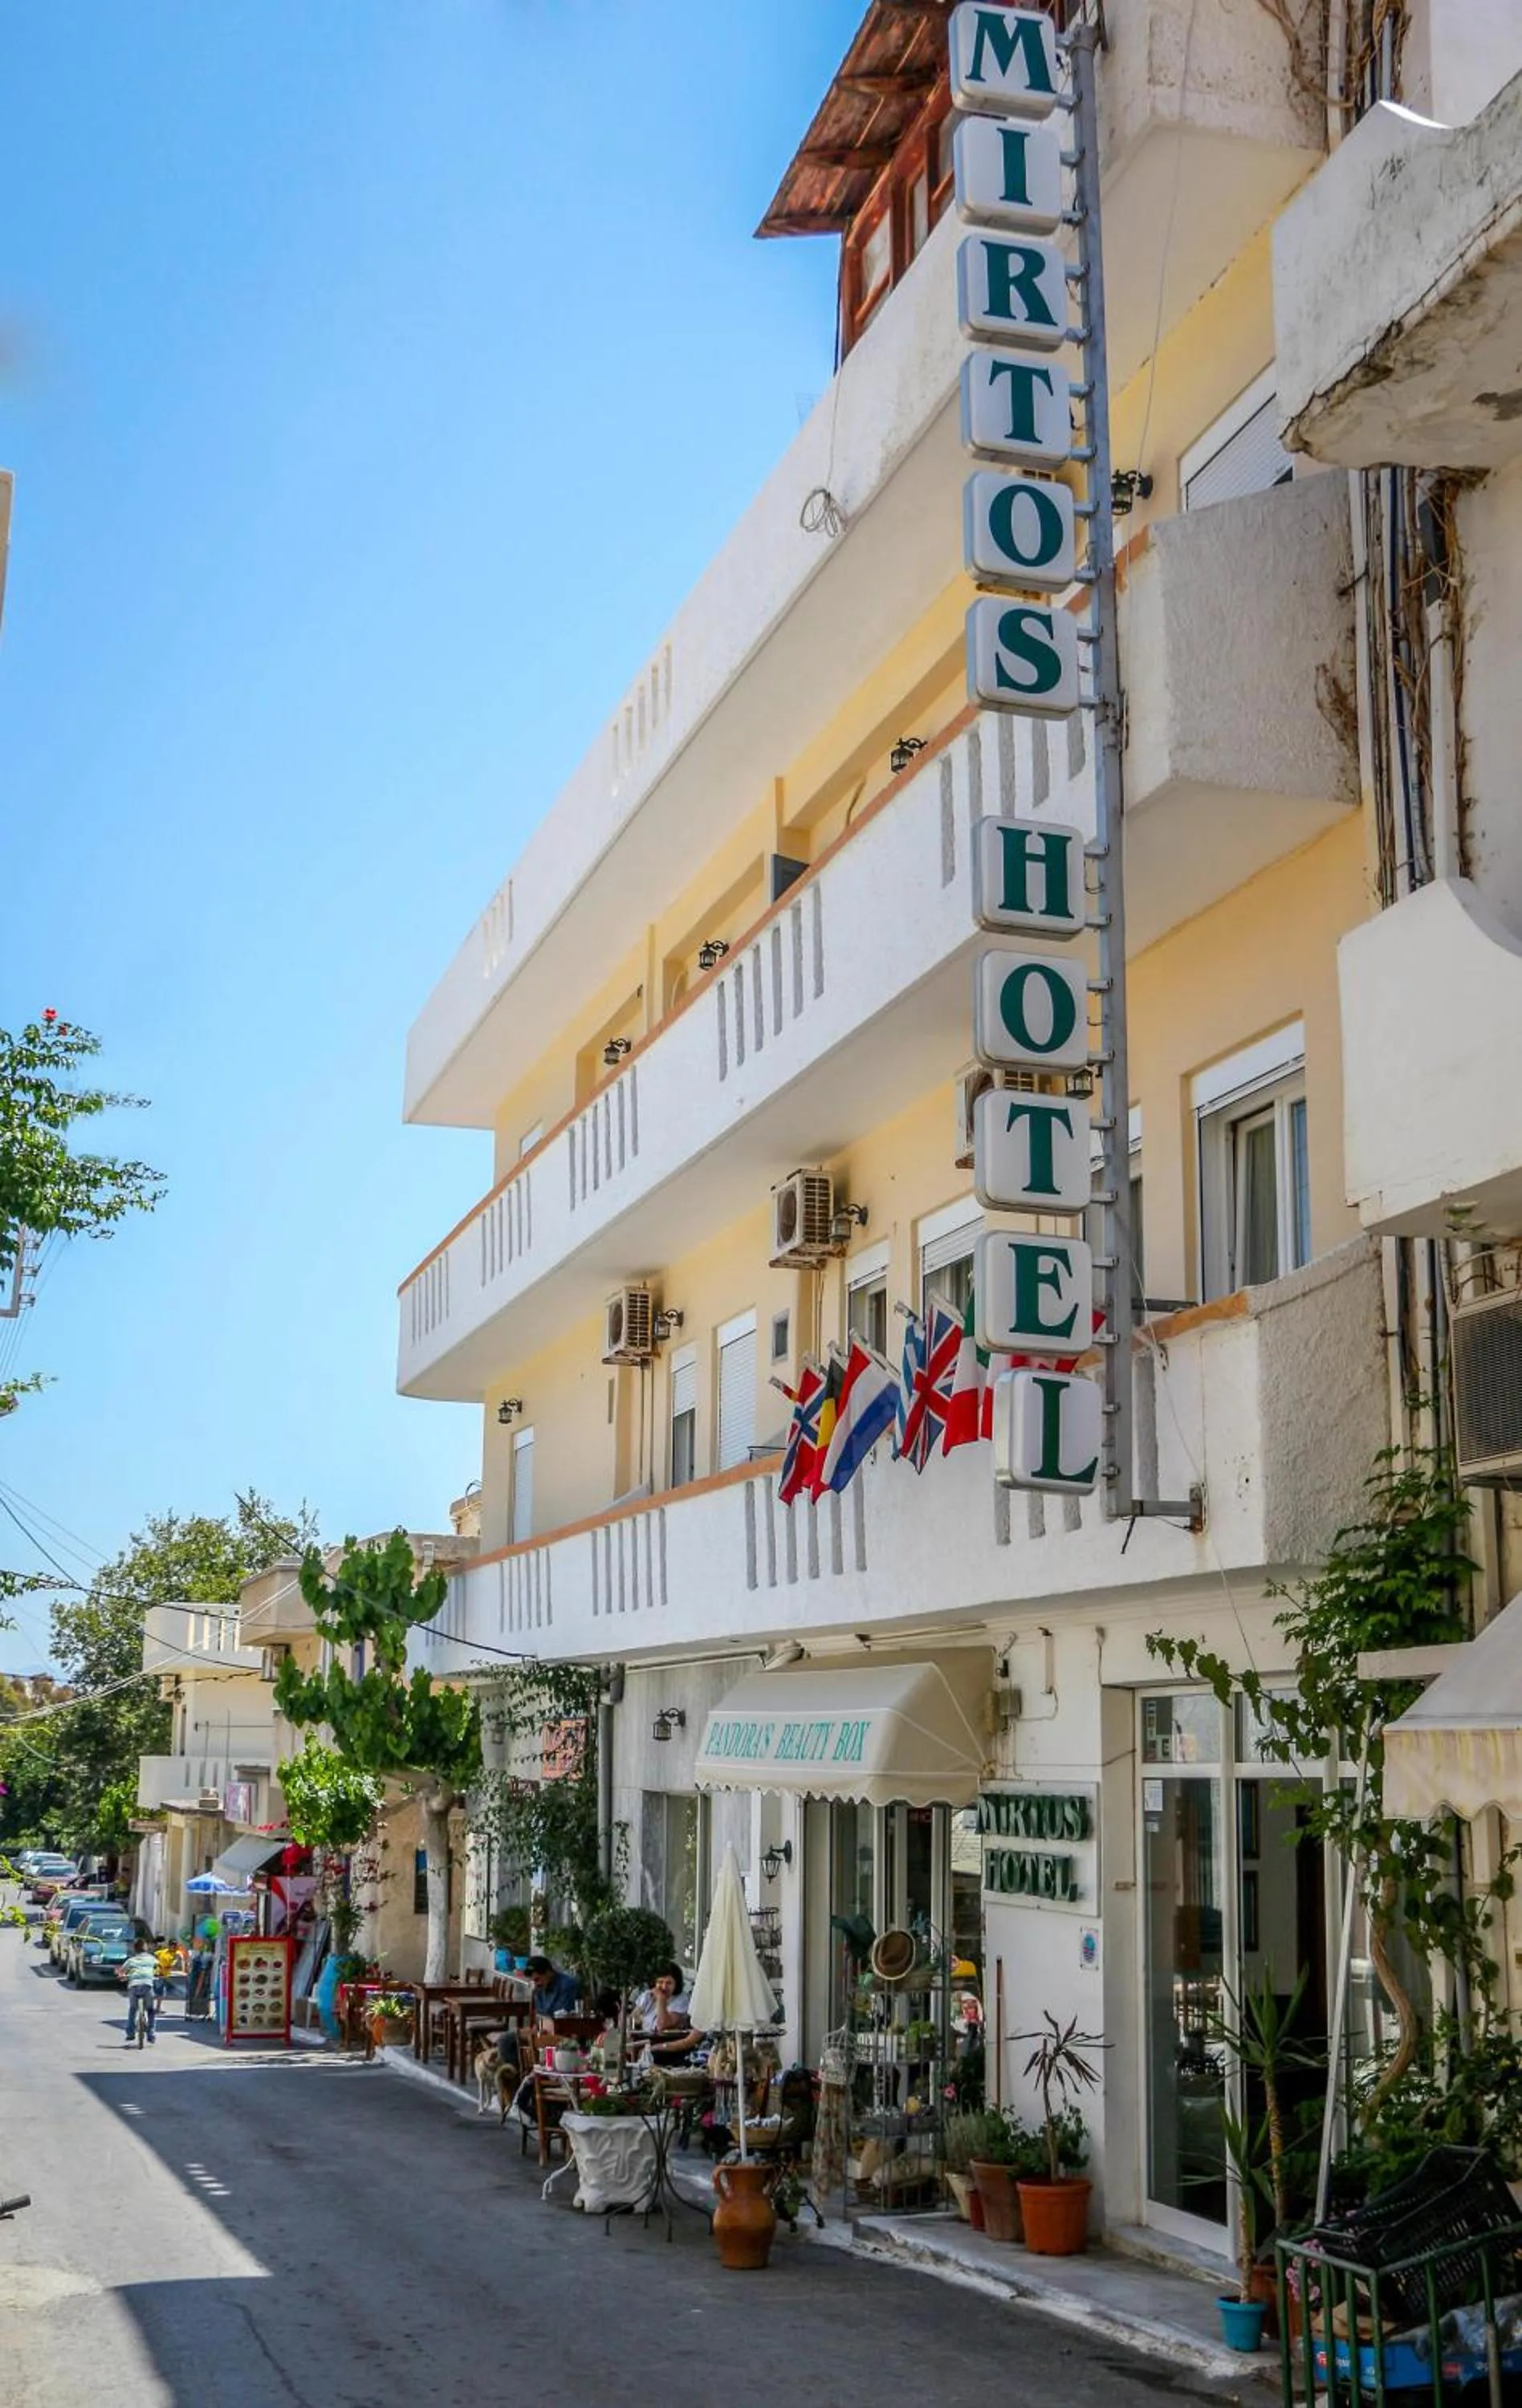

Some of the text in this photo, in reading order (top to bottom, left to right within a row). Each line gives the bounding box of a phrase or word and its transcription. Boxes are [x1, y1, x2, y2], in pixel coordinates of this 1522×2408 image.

[965, 9, 1099, 1484] MIRTOS HOTEL
[704, 1720, 872, 1762] PANDORA'S BEAUTY BOX
[983, 1848, 1078, 1902] HOTEL
